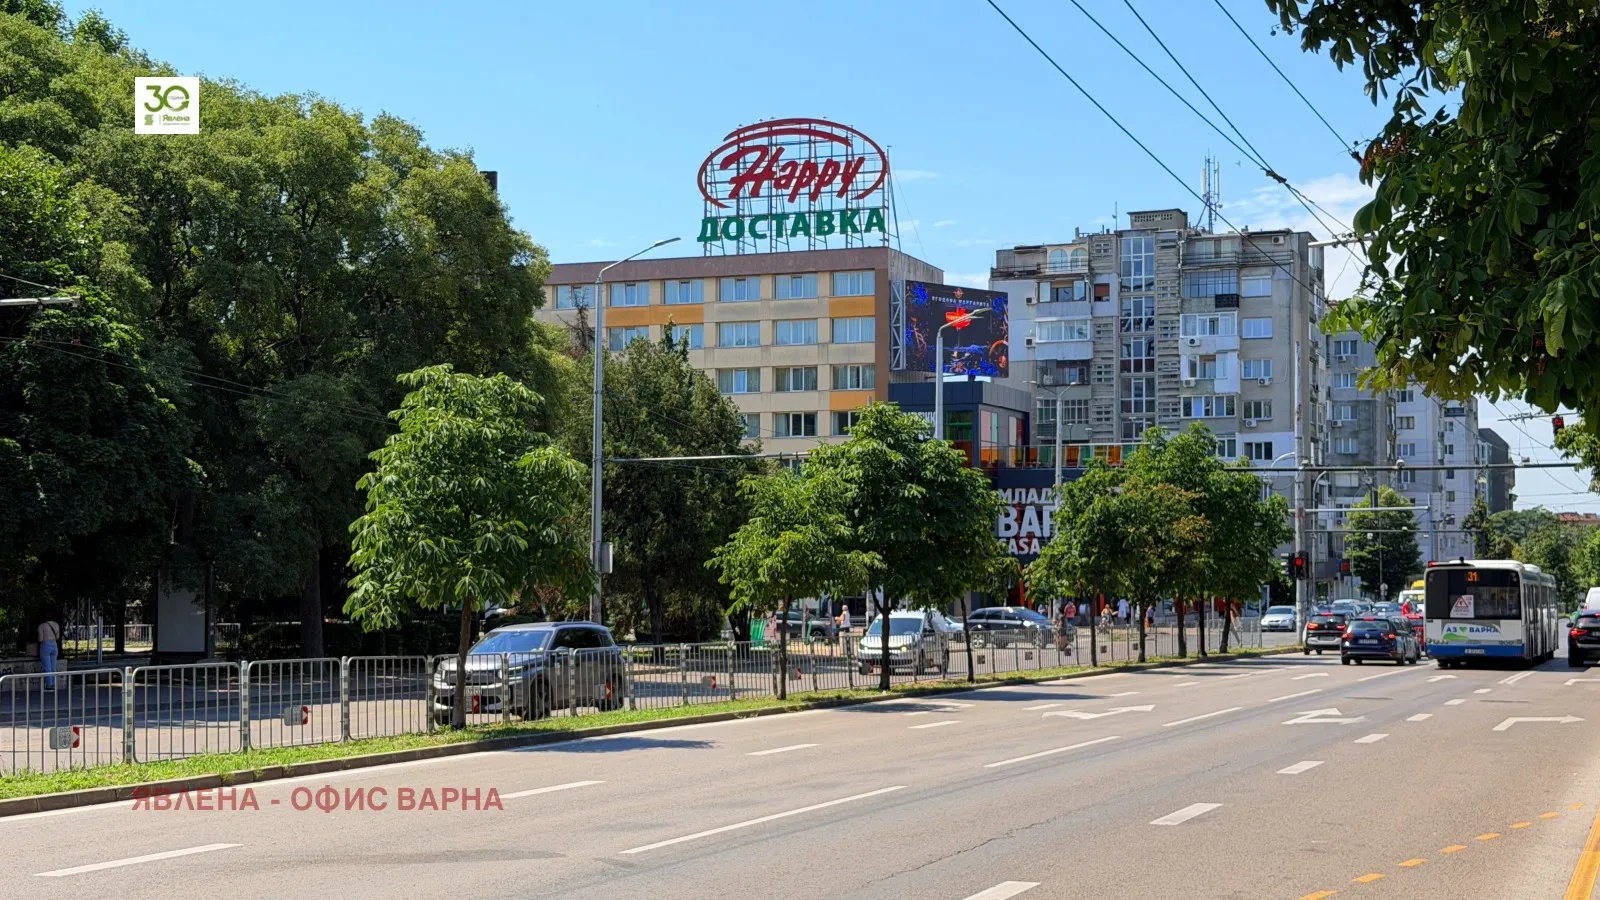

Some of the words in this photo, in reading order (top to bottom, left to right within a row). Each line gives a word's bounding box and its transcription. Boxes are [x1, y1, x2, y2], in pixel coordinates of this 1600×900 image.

[720, 145, 865, 203] Happy
[697, 207, 886, 242] ДОСТАВКА
[998, 487, 1055, 504] МЛАД
[998, 505, 1057, 537] ВАР
[998, 537, 1040, 555] ASA
[1467, 571, 1478, 581] 31
